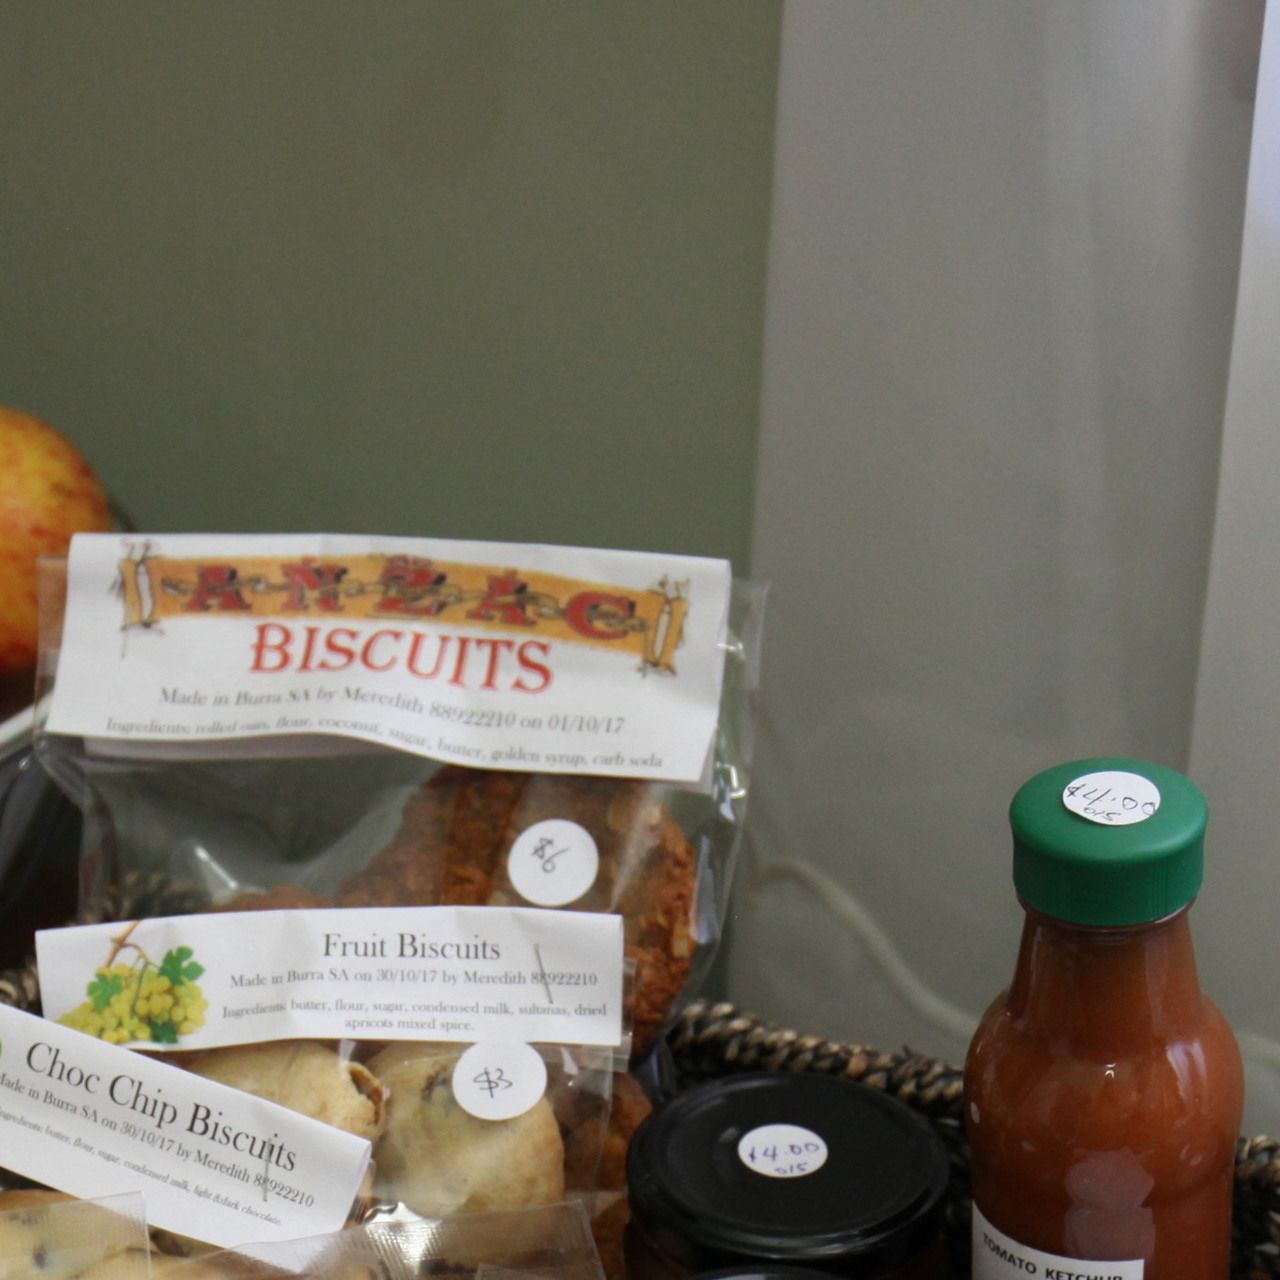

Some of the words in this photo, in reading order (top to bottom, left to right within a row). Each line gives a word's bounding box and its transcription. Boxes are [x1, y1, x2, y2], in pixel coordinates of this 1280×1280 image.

[183, 555, 636, 640] ANZAC
[250, 622, 554, 694] BISCUITS
[159, 687, 205, 706] Made
[212, 689, 229, 705] in
[234, 690, 281, 705] Burra
[288, 688, 310, 702] SA
[316, 687, 335, 704] by
[342, 687, 424, 715] Meredith
[428, 702, 517, 727] 88922210
[519, 715, 542, 730] on
[547, 715, 625, 733] 01/10/17
[490, 744, 540, 763] golden
[592, 751, 624, 767] carb
[629, 751, 663, 768] soda
[323, 932, 388, 958] Fruit
[397, 932, 501, 960] Biscuits
[229, 973, 268, 988] Made
[271, 975, 283, 985] in
[287, 969, 324, 984] Burra
[328, 968, 349, 982] SA
[354, 971, 372, 982] on
[376, 968, 437, 983] 30/10/17
[442, 970, 458, 985] by
[463, 970, 526, 985] Meredith
[335, 998, 369, 1013] flour,
[411, 1002, 480, 1016] condensed
[483, 1003, 515, 1016] milk,
[574, 1003, 607, 1016] dried
[344, 1017, 394, 1030] apricots
[397, 1018, 436, 1030] mixed
[473, 1067, 513, 1099] $3
[26, 1042, 101, 1094] Choc
[109, 1074, 177, 1129] Chip
[186, 1102, 297, 1172] Biscuits
[28, 1084, 40, 1100] in
[43, 1090, 78, 1114] Burra
[79, 1104, 98, 1123] SA
[101, 1117, 118, 1130] on
[119, 1120, 175, 1151] 30/10/17
[176, 1143, 192, 1160] by
[193, 1150, 251, 1183] Meredith
[983, 1232, 1037, 1274] TOMATO
